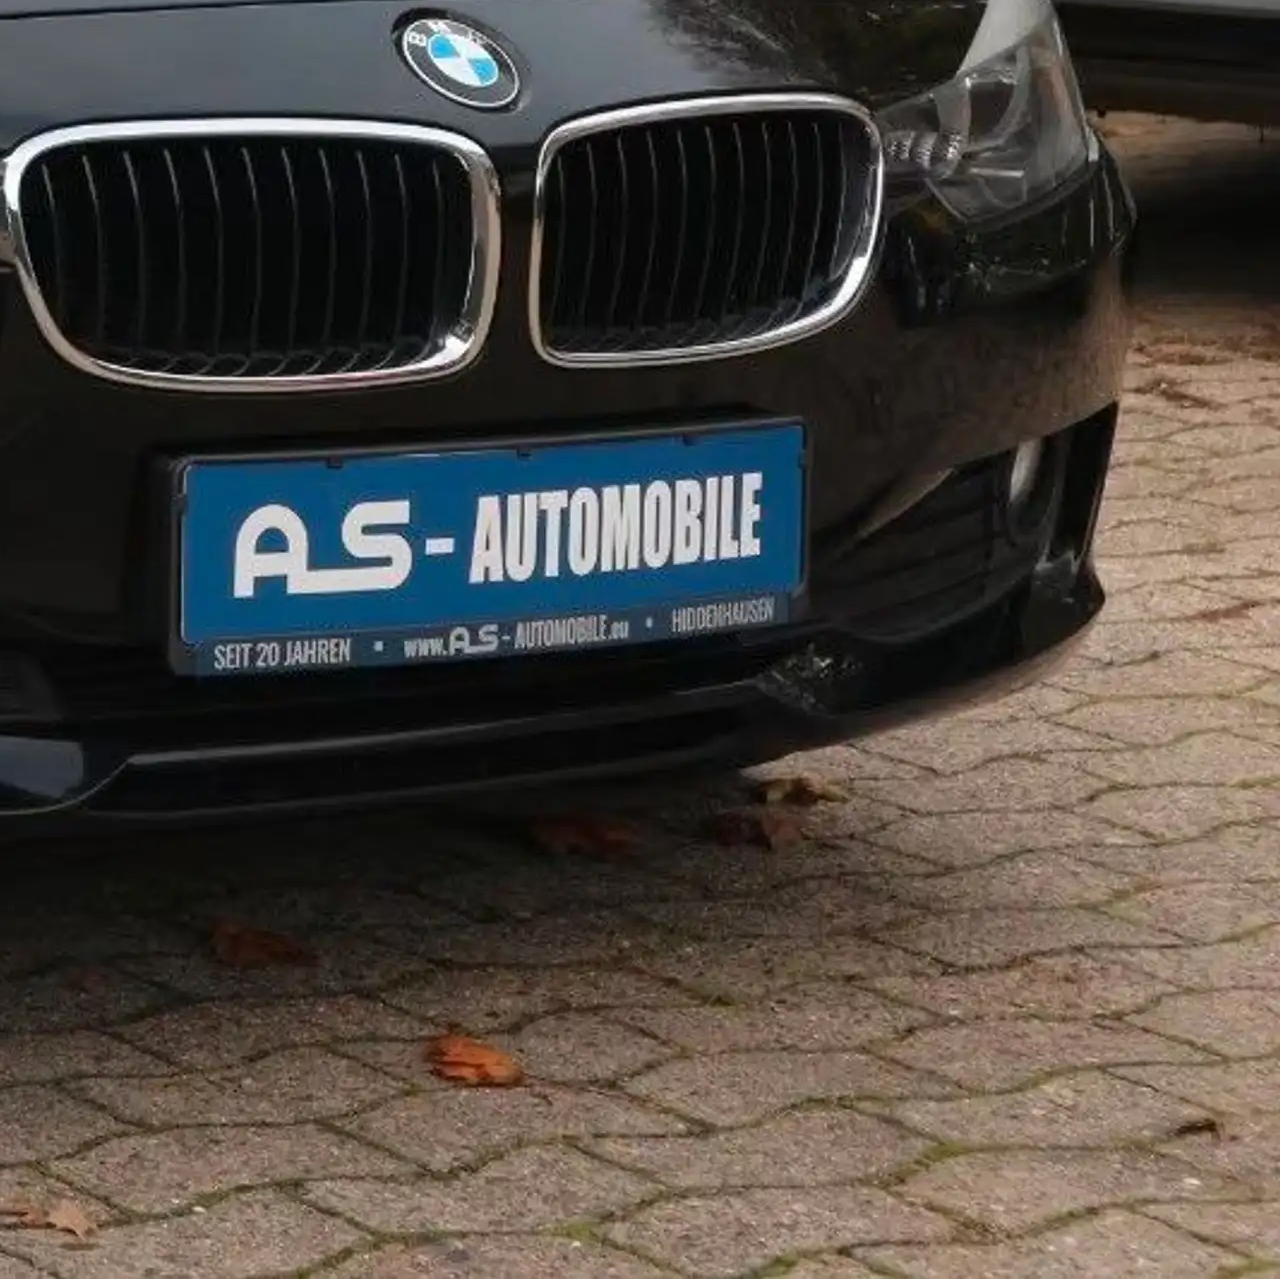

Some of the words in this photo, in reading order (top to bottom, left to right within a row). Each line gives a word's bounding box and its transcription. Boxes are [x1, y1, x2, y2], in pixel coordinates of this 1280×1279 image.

[214, 642, 253, 670] SEIT
[255, 642, 282, 668] 20
[283, 637, 352, 667] JAHREN
